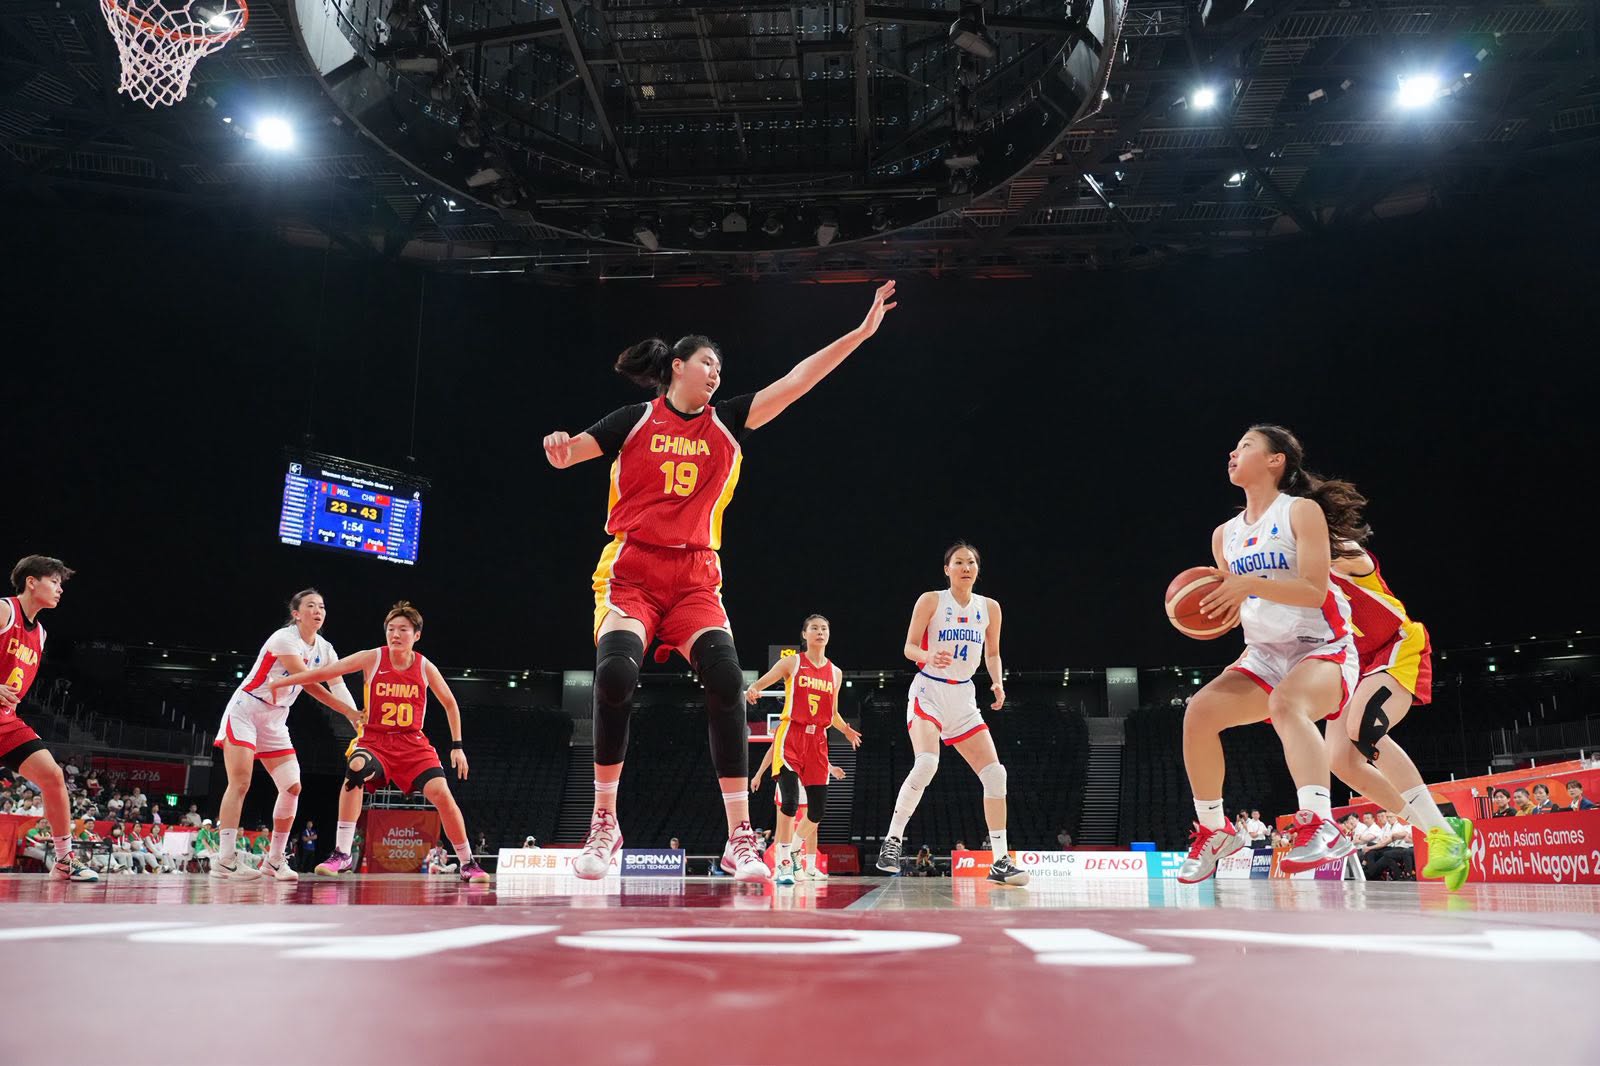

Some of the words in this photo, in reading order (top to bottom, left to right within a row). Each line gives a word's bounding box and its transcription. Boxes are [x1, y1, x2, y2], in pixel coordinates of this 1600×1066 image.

[650, 434, 711, 456] CHINA
[659, 461, 699, 497] 19
[337, 487, 350, 498] MGL
[361, 493, 376, 503] CHN
[330, 500, 348, 514] 23
[360, 507, 378, 520] 43
[341, 520, 364, 533] 1:54
[938, 629, 982, 644] MONGOLIA
[7, 637, 38, 667] CHINA
[953, 644, 968, 661] 14
[5, 666, 24, 695] 6
[798, 675, 833, 694] CHINA
[375, 682, 419, 698] CHINA
[807, 693, 821, 717] 5
[380, 702, 414, 727] 20
[387, 827, 419, 837] Aichi-
[1488, 829, 1512, 848] 20th
[1513, 828, 1542, 847] Asian
[1543, 828, 1585, 845] Games
[382, 837, 423, 849] Nagoya
[388, 848, 416, 859] 2026
[624, 854, 682, 864] BORNAN
[1041, 854, 1075, 864] MUFG
[500, 854, 558, 869] JR東海
[955, 857, 976, 869] JTB
[1084, 858, 1144, 871] DENSO
[1492, 850, 1590, 882] Aichi-Nagoya
[1028, 869, 1051, 877] MUFG
[1052, 869, 1072, 877] Bank
